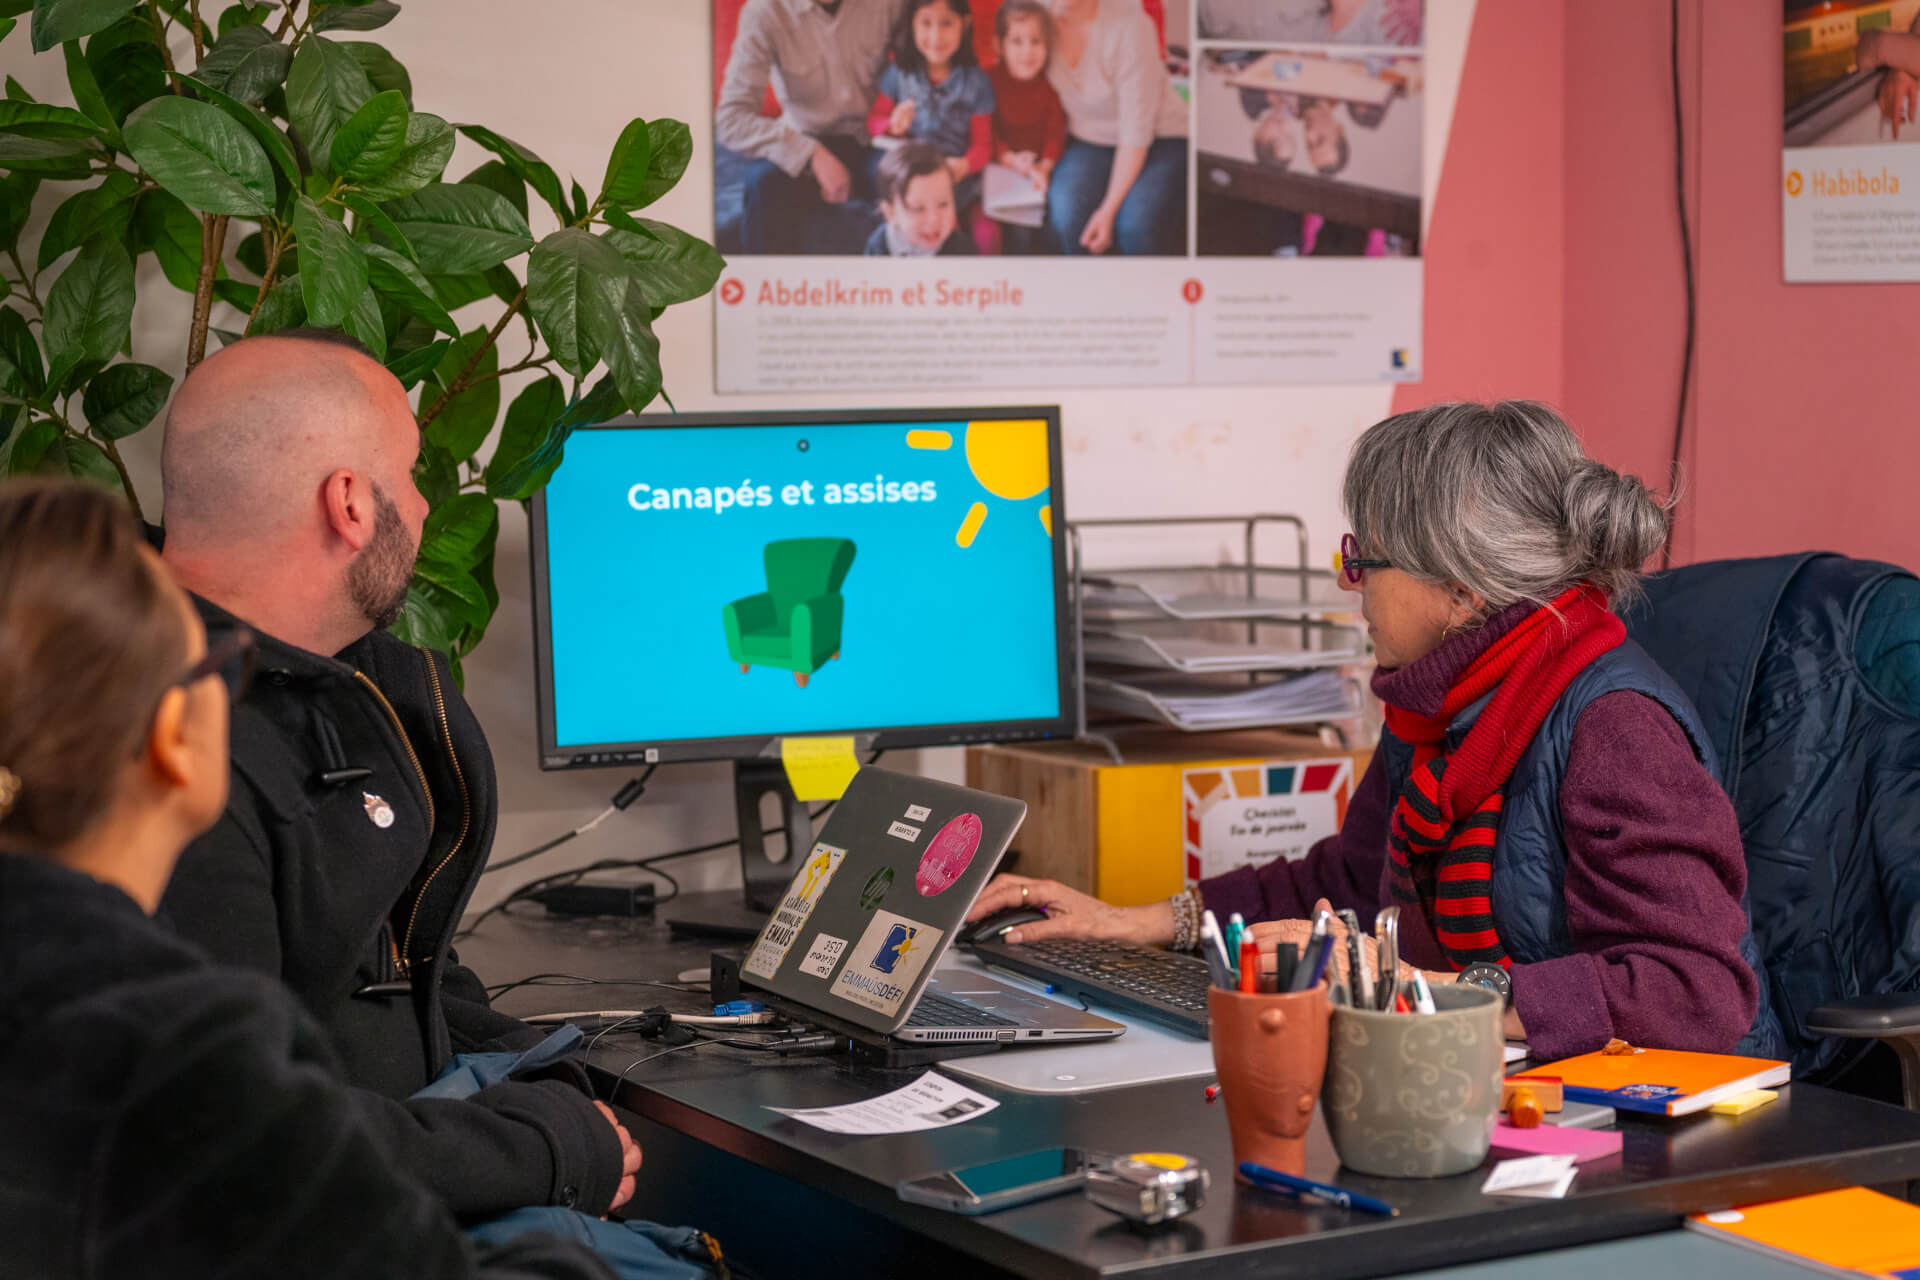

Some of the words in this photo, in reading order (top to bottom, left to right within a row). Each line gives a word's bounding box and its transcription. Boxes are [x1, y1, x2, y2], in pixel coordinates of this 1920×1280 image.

[1811, 168, 1900, 197] Habibola
[757, 278, 893, 306] Abdelkrim
[901, 279, 926, 306] et
[935, 278, 1025, 313] Serpile
[627, 478, 773, 514] Canapés
[781, 480, 815, 505] et
[824, 474, 938, 504] assises
